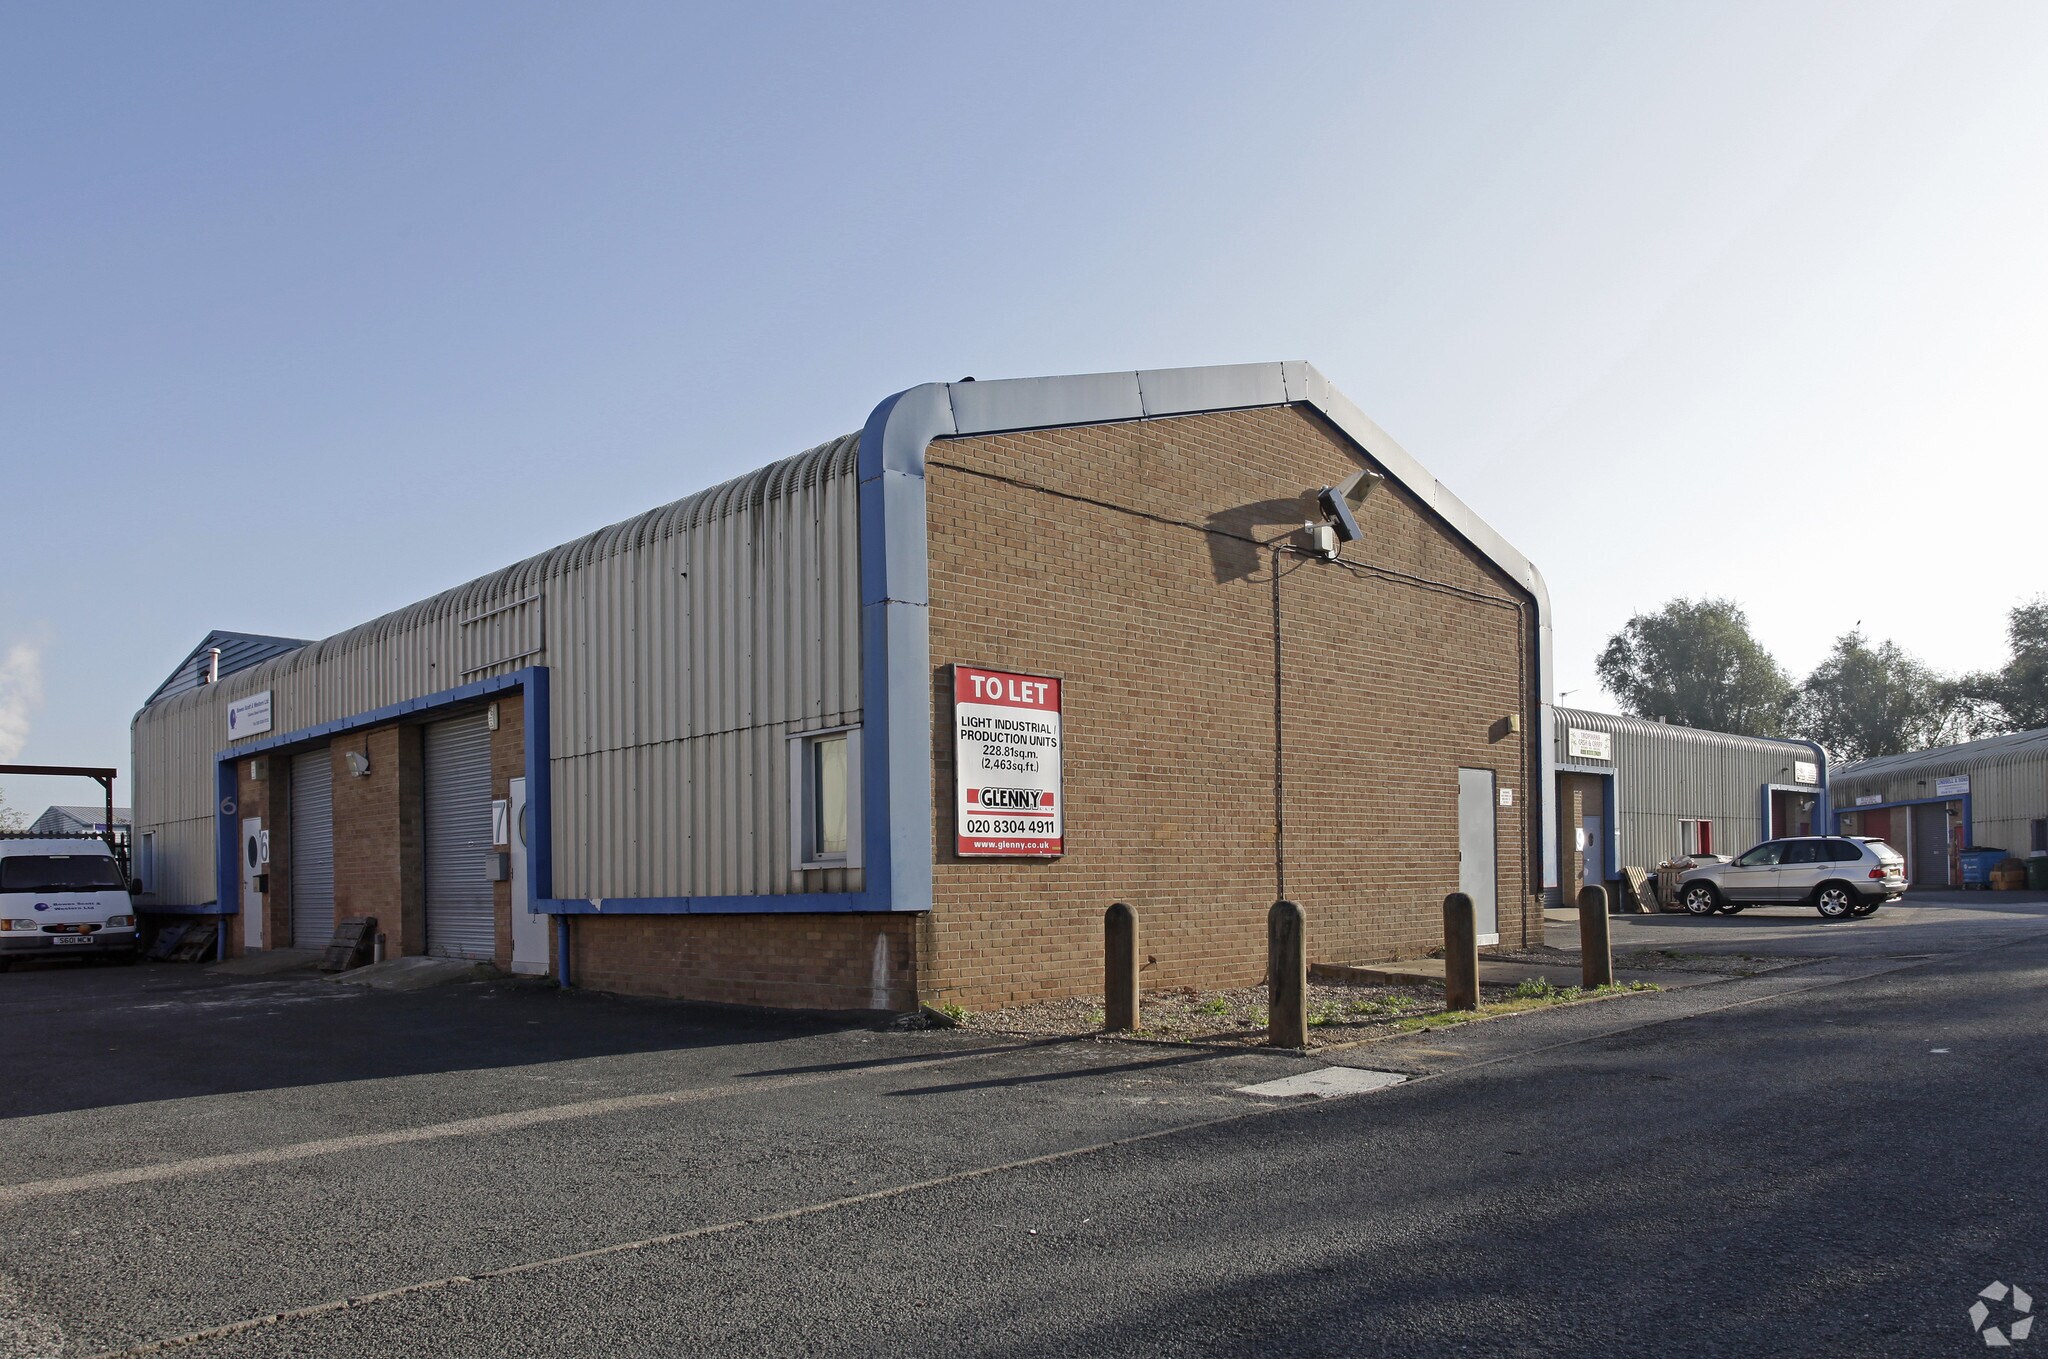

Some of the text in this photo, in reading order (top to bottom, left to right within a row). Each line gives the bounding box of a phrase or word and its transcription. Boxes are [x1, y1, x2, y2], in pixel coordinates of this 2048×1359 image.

[970, 675, 1049, 705] TO LET
[961, 716, 993, 729] LIGHT
[994, 718, 1052, 735] INDUSTRIAL
[961, 730, 1058, 748] PRODUCTION UNITS
[982, 745, 1039, 760] 228.81sq.m.
[981, 758, 1040, 773] (2,463sq.ft.)
[220, 796, 237, 815] 6
[980, 787, 1043, 809] GLENNY
[492, 801, 505, 843] 7
[967, 819, 1055, 834] 020 8304 4911
[261, 831, 268, 862] 6
[973, 840, 1050, 850] www.glenny.co.uk
